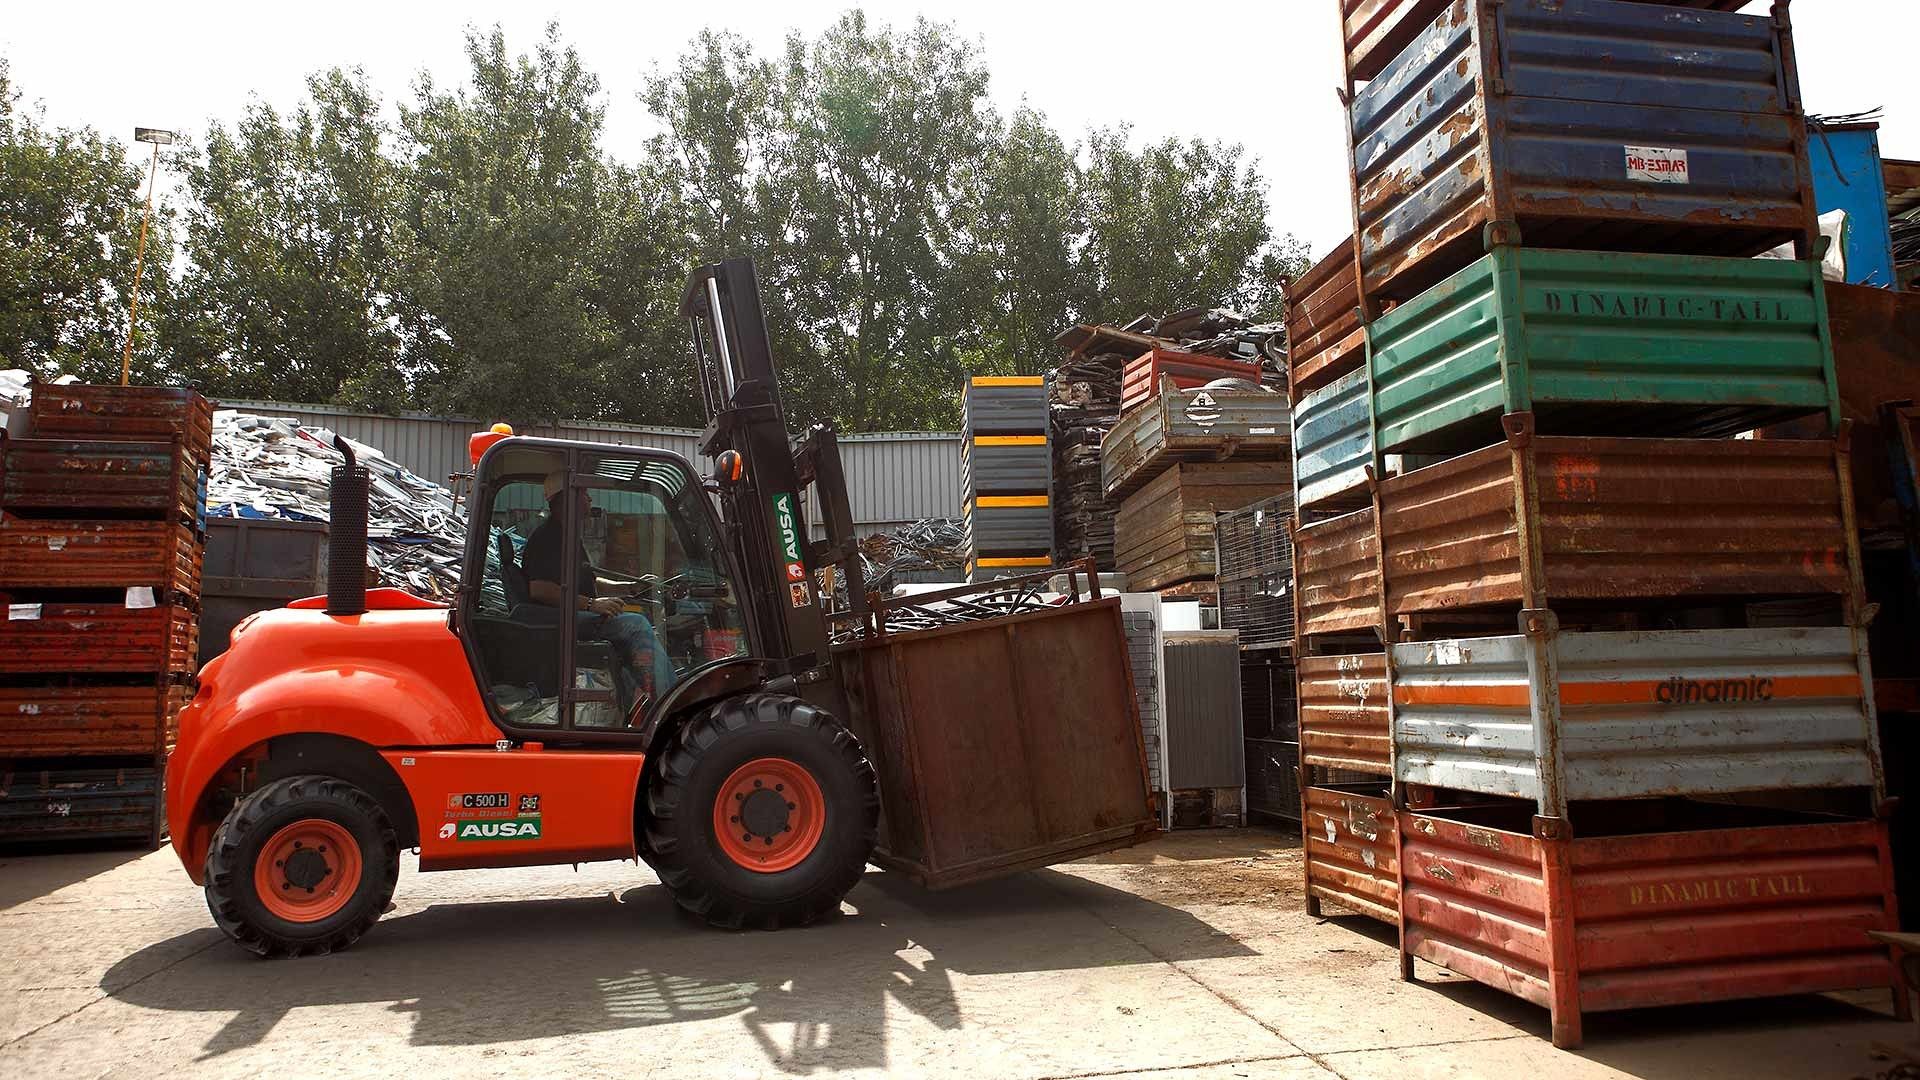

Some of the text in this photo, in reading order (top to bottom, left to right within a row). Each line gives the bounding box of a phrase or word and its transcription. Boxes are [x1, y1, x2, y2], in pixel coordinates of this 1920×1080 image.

[777, 496, 799, 560] AUSA
[1656, 674, 1774, 704] dinamic
[464, 795, 508, 807] C 500 H
[460, 823, 539, 837] AUSA
[1630, 874, 1811, 905] DINAMIC TALL
